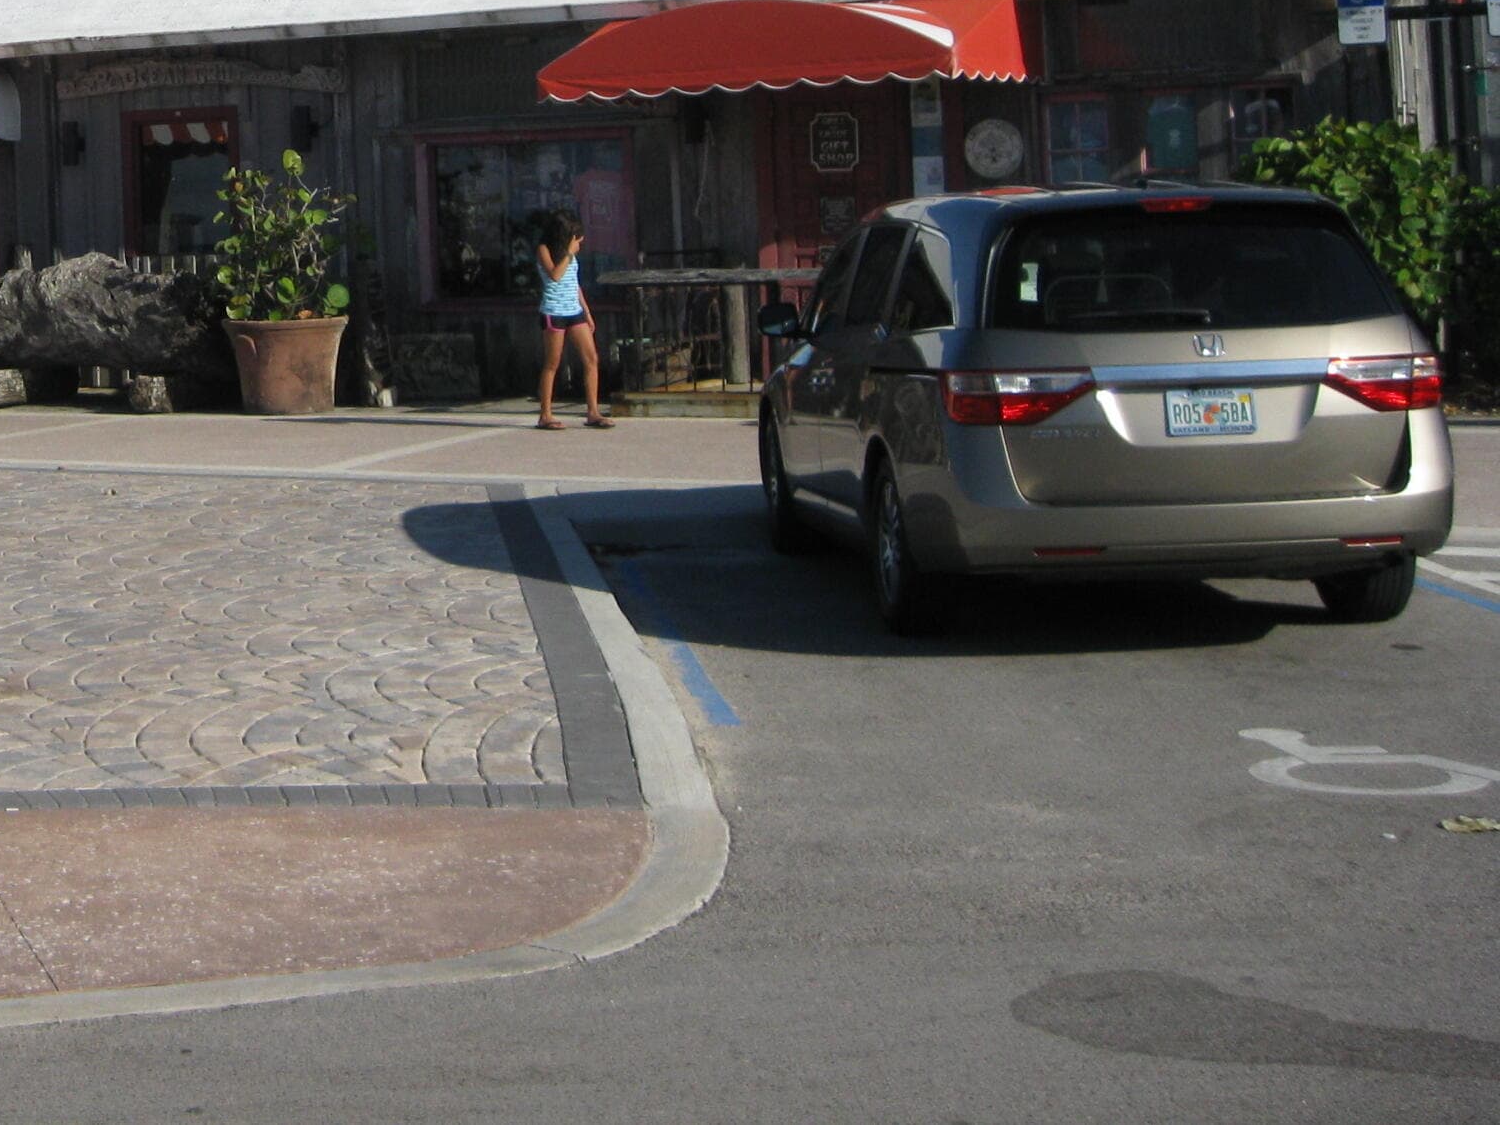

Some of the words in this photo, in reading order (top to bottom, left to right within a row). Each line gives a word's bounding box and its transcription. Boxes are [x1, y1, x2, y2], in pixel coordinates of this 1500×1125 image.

[820, 141, 849, 153] GIFT
[819, 153, 854, 165] SHOP
[1221, 402, 1249, 423] 5BA
